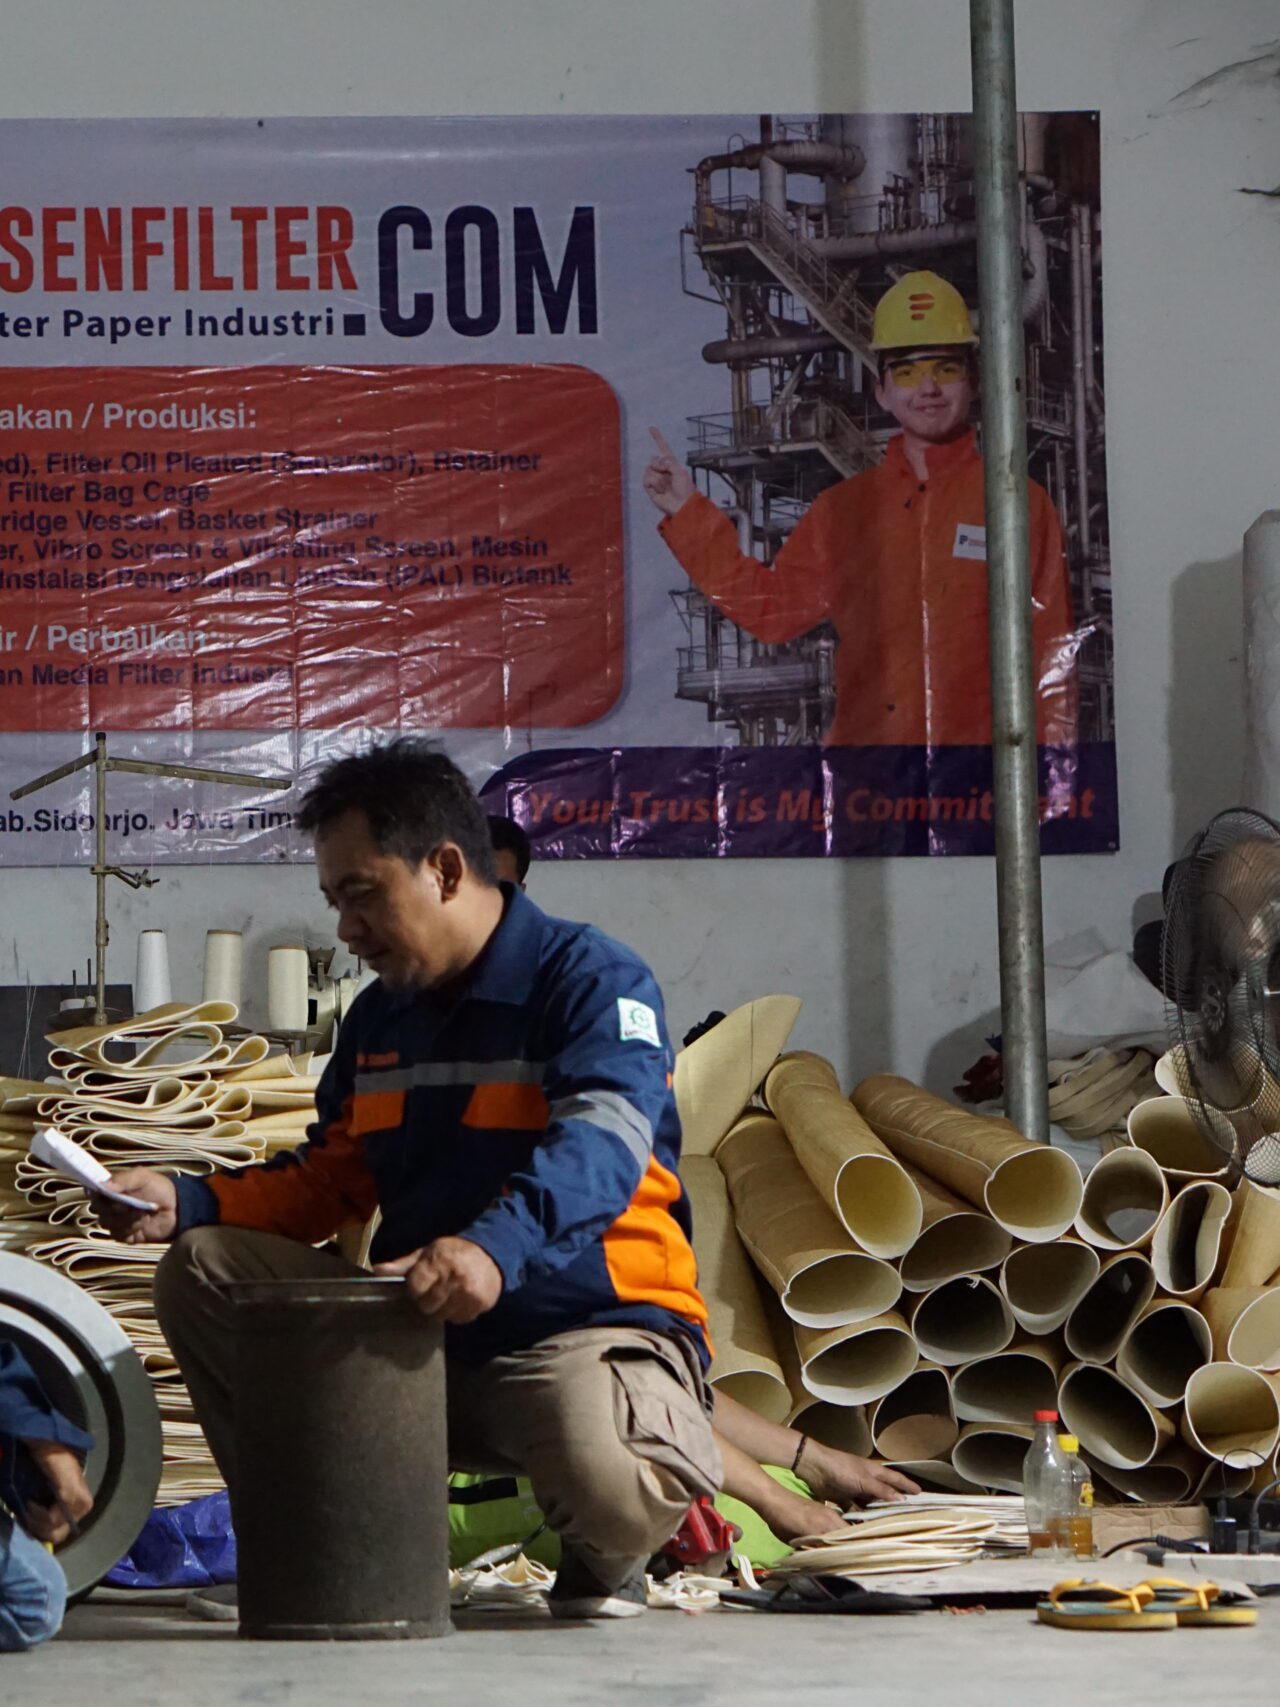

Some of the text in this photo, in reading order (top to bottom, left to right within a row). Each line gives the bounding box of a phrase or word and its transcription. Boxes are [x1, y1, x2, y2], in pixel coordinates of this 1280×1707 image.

[63, 310, 172, 345] Paper
[185, 307, 335, 338] Industri
[80, 404, 95, 430] /
[102, 402, 257, 430] Produksi:
[46, 453, 113, 474] Filter
[120, 451, 157, 473] Oil
[165, 451, 261, 473] Pleated
[433, 450, 541, 472] Retainer
[8, 482, 75, 503] Filter
[83, 481, 136, 508] Bag
[142, 480, 211, 507] Cage
[76, 510, 170, 535] Vessel,
[177, 509, 267, 531] Basket
[274, 508, 379, 530] Strainer
[32, 538, 104, 560] Vibro
[110, 537, 202, 560] Screen
[211, 538, 229, 560] &
[238, 537, 356, 563] Vibrating
[471, 536, 549, 557] Mesin
[385, 565, 464, 592] (IPAL)
[472, 563, 574, 587] Biotank
[24, 626, 36, 652] /
[31, 663, 109, 686] Media
[118, 662, 185, 685] Filter
[165, 807, 234, 831] Jawa
[527, 790, 612, 825] Your
[627, 790, 720, 823] Trust
[736, 788, 767, 822] is
[776, 789, 831, 832] My
